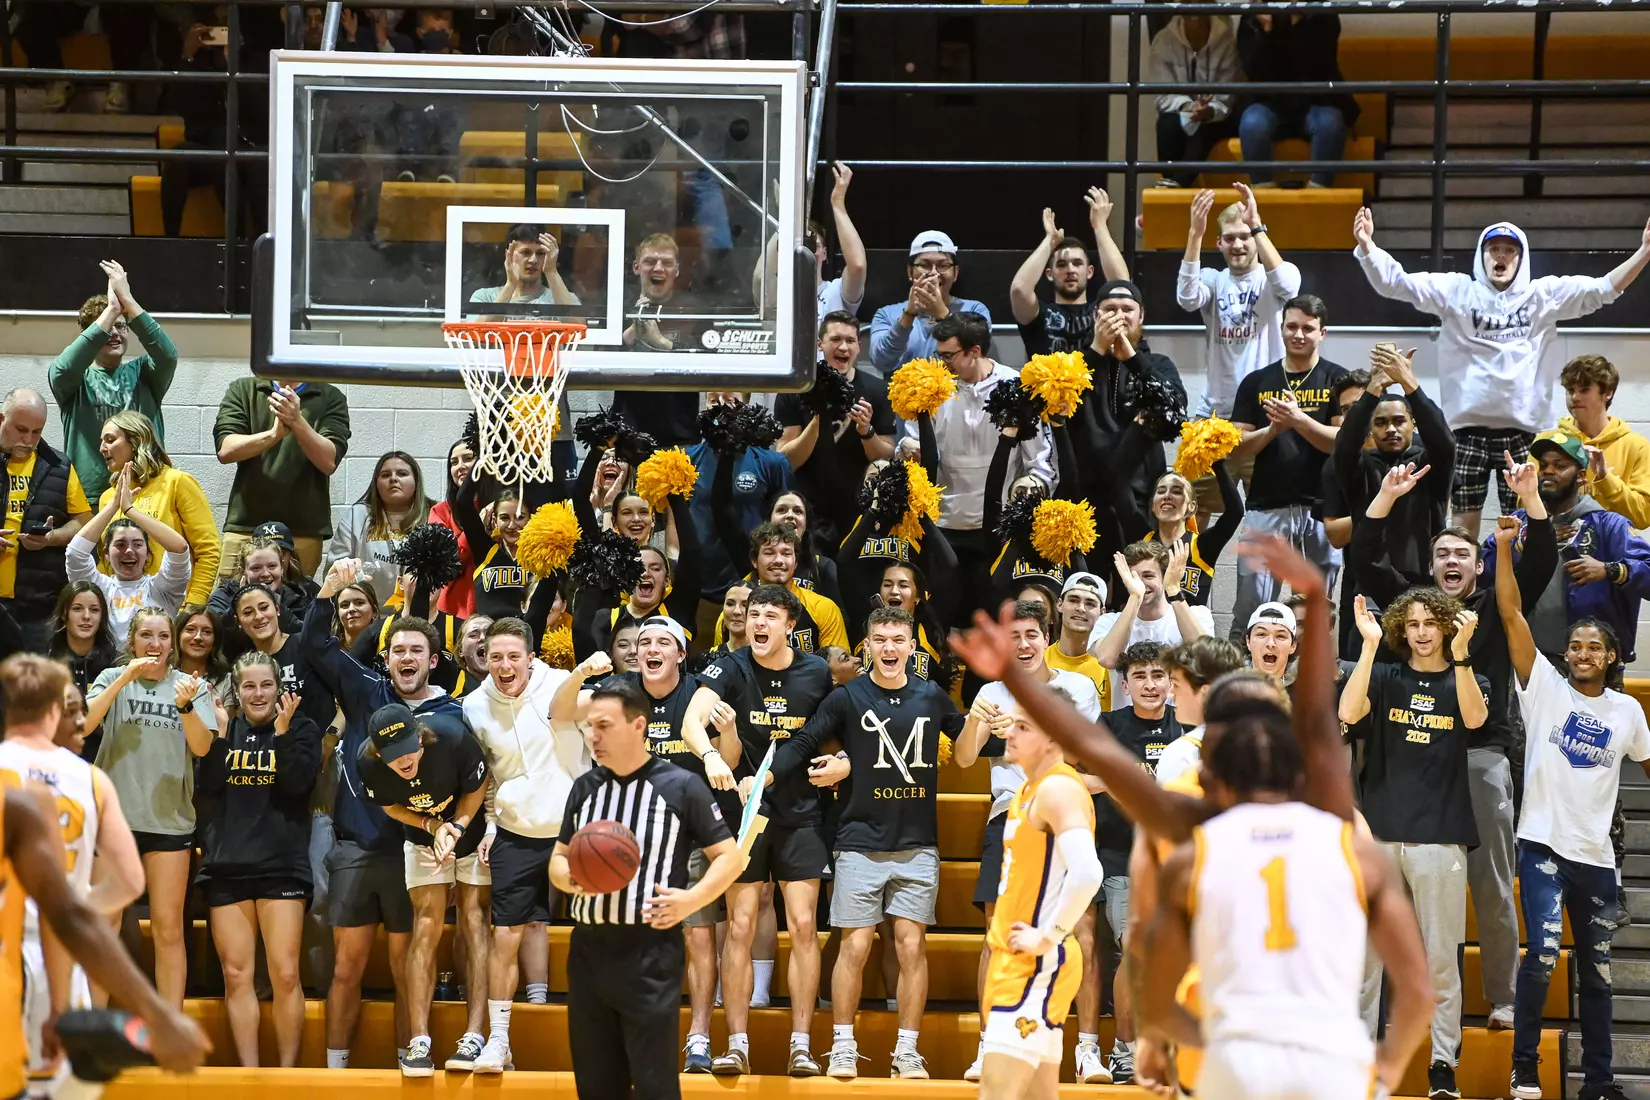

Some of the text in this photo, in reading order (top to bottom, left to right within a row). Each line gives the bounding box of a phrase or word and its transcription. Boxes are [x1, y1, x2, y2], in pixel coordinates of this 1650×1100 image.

[722, 329, 774, 343] SCHUTT
[1258, 388, 1331, 405] MILLESVILLE
[127, 698, 178, 722] VILLE
[764, 701, 787, 709] PSAC
[1411, 698, 1435, 708] PSAC
[122, 717, 183, 731] ACROSSE
[1388, 708, 1454, 729] CHAMPIONS
[648, 727, 671, 735] PSAC
[1405, 729, 1431, 744] 2021
[1576, 731, 1596, 744] 2021
[1548, 725, 1617, 769] CHAMPIONS
[873, 787, 926, 799] SOCCER
[1260, 856, 1298, 952] 1
